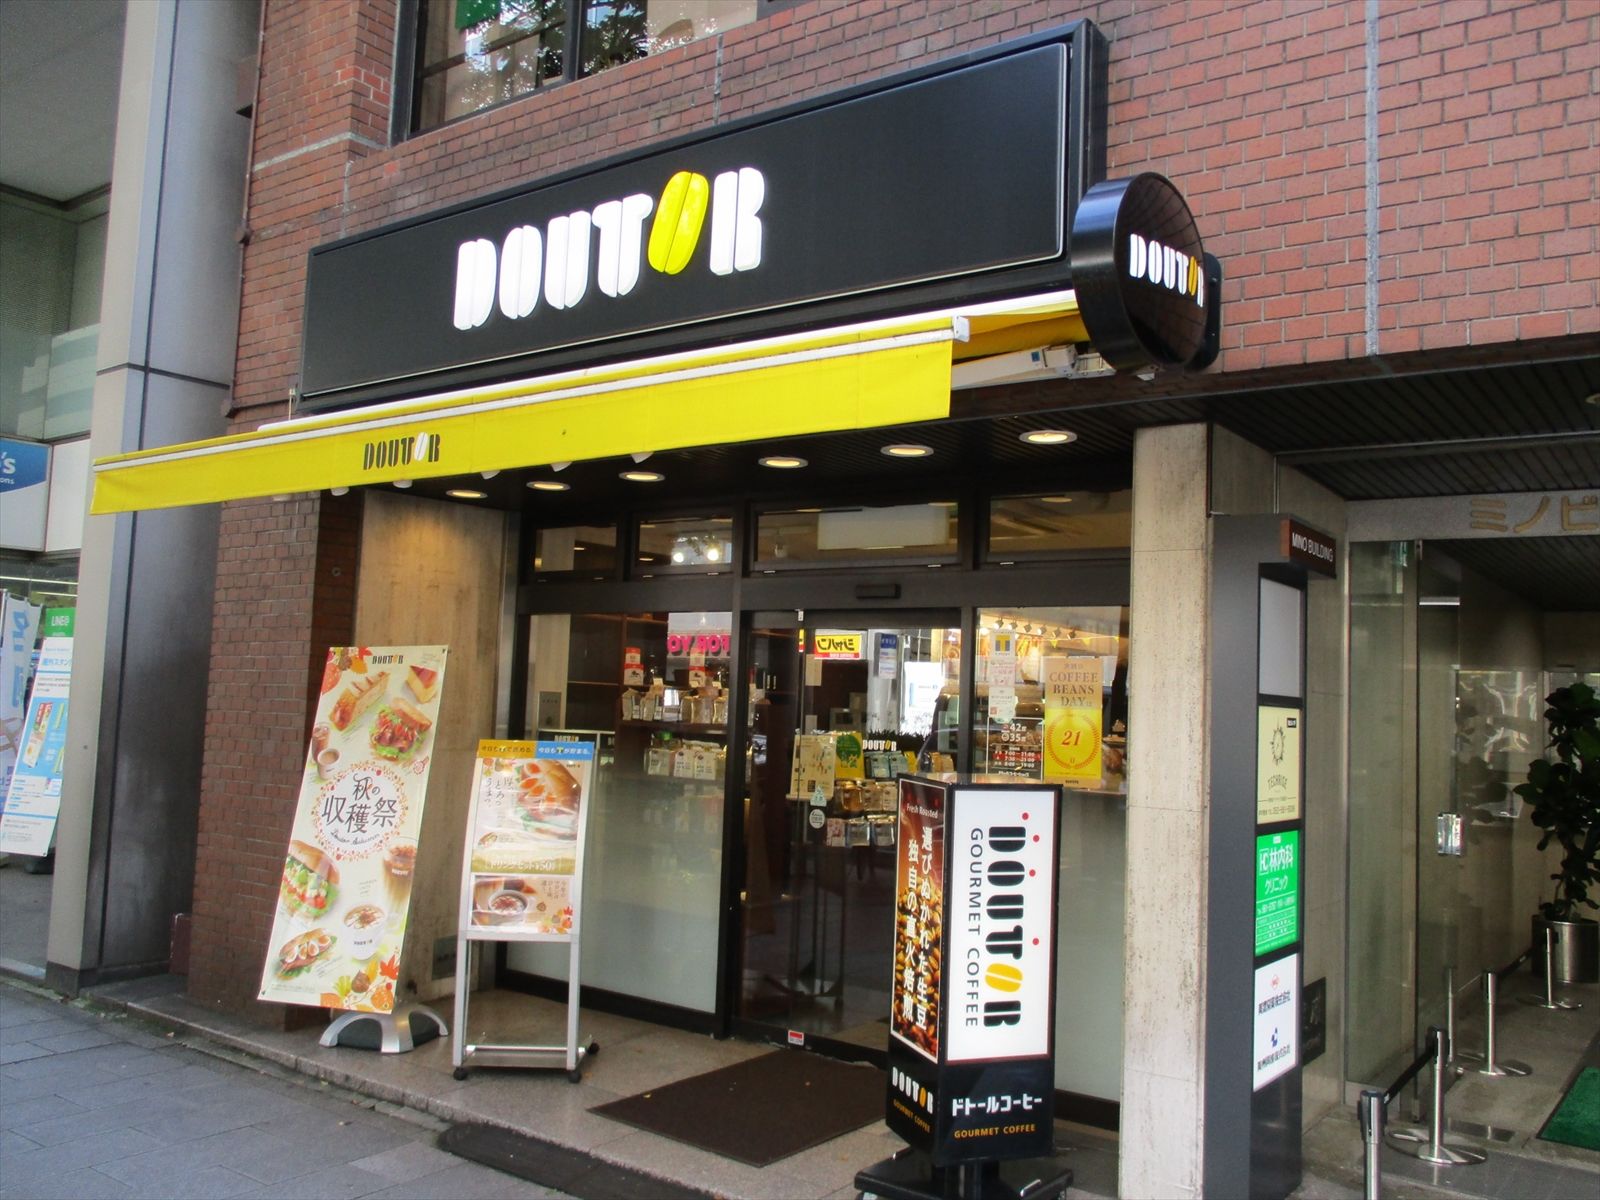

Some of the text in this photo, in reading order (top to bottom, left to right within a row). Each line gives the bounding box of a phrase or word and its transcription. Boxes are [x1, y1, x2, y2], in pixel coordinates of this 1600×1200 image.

[453, 166, 765, 331] DOUTOR
[1129, 233, 1204, 308] DOUTOR
[363, 431, 441, 470] DOUTOR
[1292, 532, 1334, 562] MINO BUILDING
[1049, 671, 1099, 683] COFFEE
[1053, 684, 1095, 695] BEANS
[862, 739, 897, 752] DOUTOR
[1061, 729, 1081, 746] 21
[352, 773, 381, 801] 秋の
[321, 795, 398, 834] 収穫祭
[906, 803, 939, 819] Fresh Roasted
[916, 826, 933, 1031] 選びぬかれた生豆
[965, 827, 984, 1027] GOURMET COFFEE
[983, 826, 1027, 1028] DOUTOR
[892, 1066, 934, 1114] DOUTOR
[951, 1092, 1043, 1117] ドトールコーヒー
[953, 1123, 1036, 1139] GOURMET COFFEE
